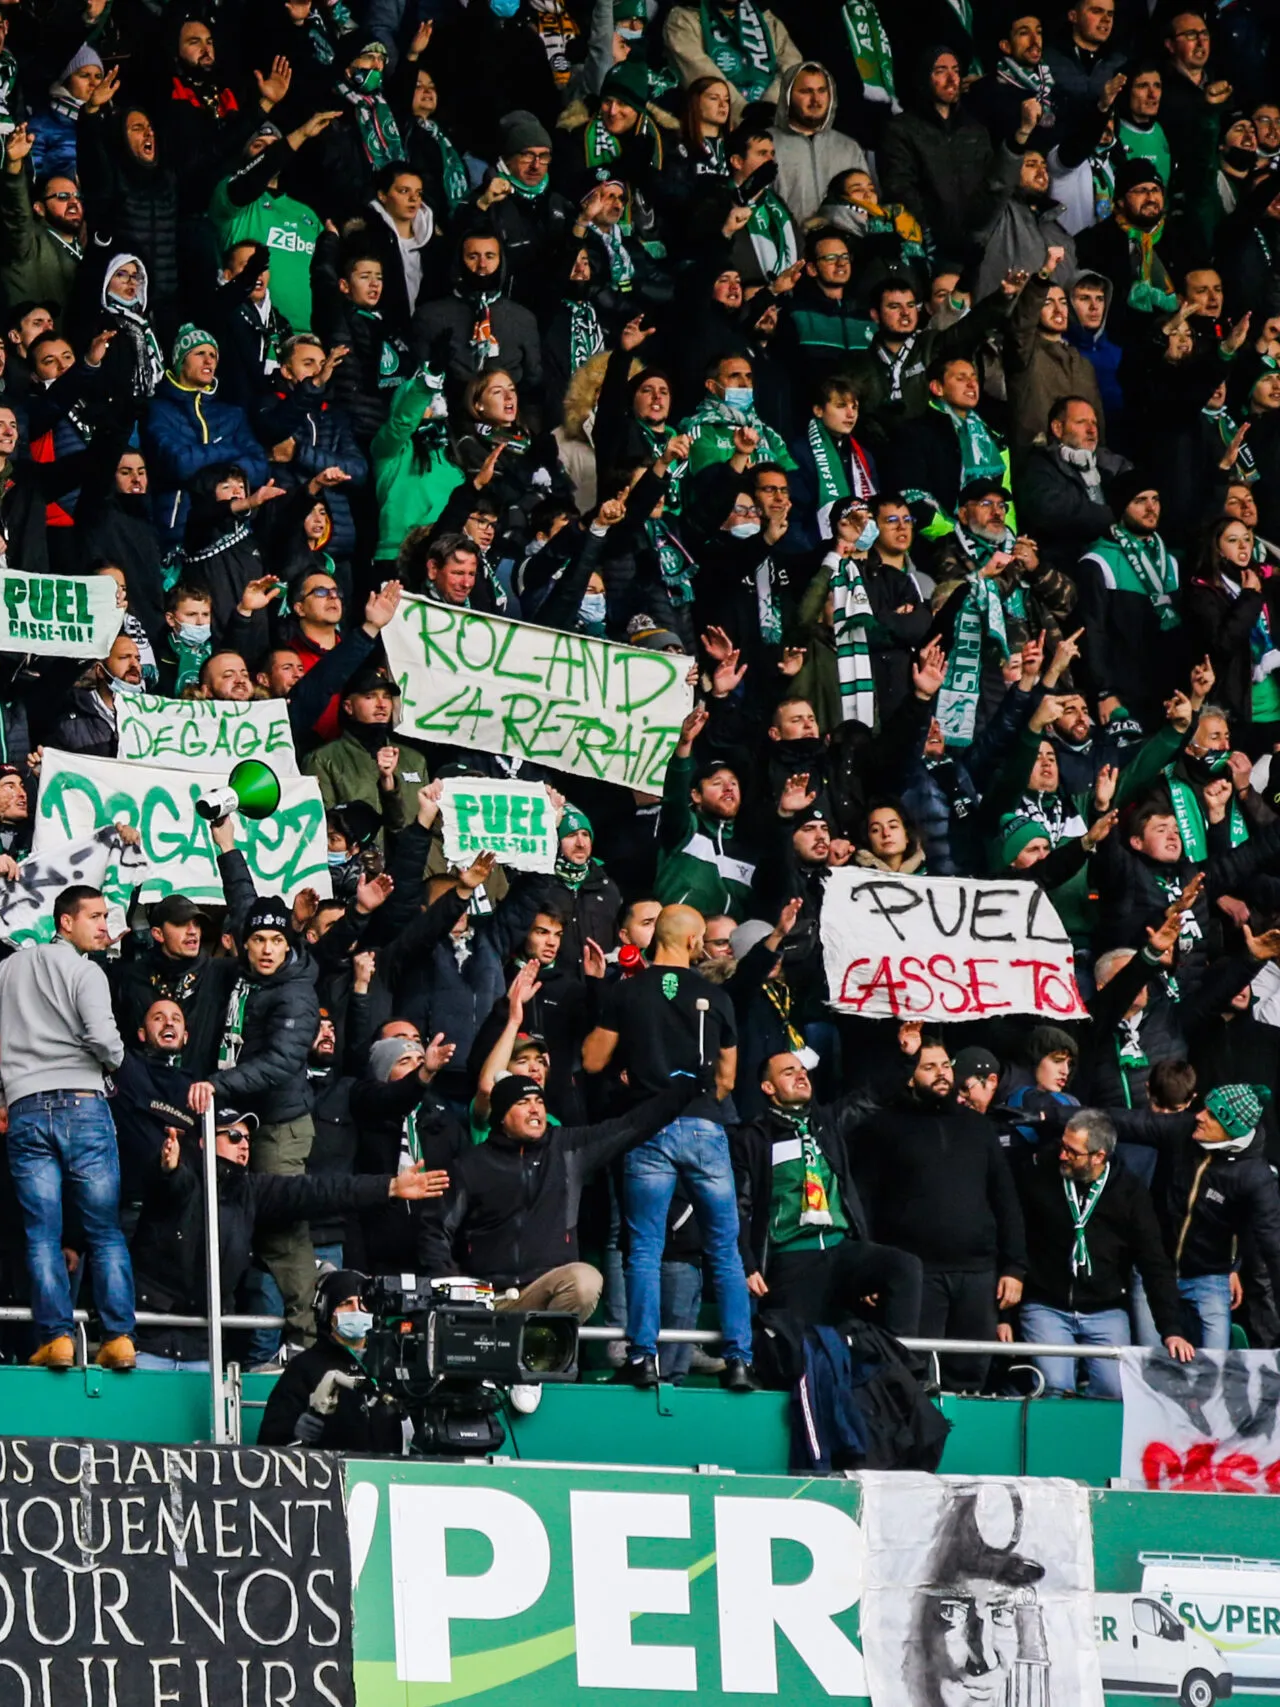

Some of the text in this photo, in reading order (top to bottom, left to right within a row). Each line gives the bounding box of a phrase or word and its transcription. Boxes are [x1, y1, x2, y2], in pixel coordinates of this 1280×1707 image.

[4, 577, 94, 624] PUEL
[403, 602, 677, 716] ROLAND
[122, 716, 293, 760] DEGAGE
[415, 686, 494, 741] LA
[452, 793, 548, 836] PUEL
[851, 881, 1071, 942] PUEL
[839, 954, 1012, 1015] CASSE
[49, 1442, 333, 1490] CHANTONS
[169, 1567, 341, 1647] NOS
[348, 1480, 872, 1697] PER
[1178, 1602, 1280, 1635] SUPER
